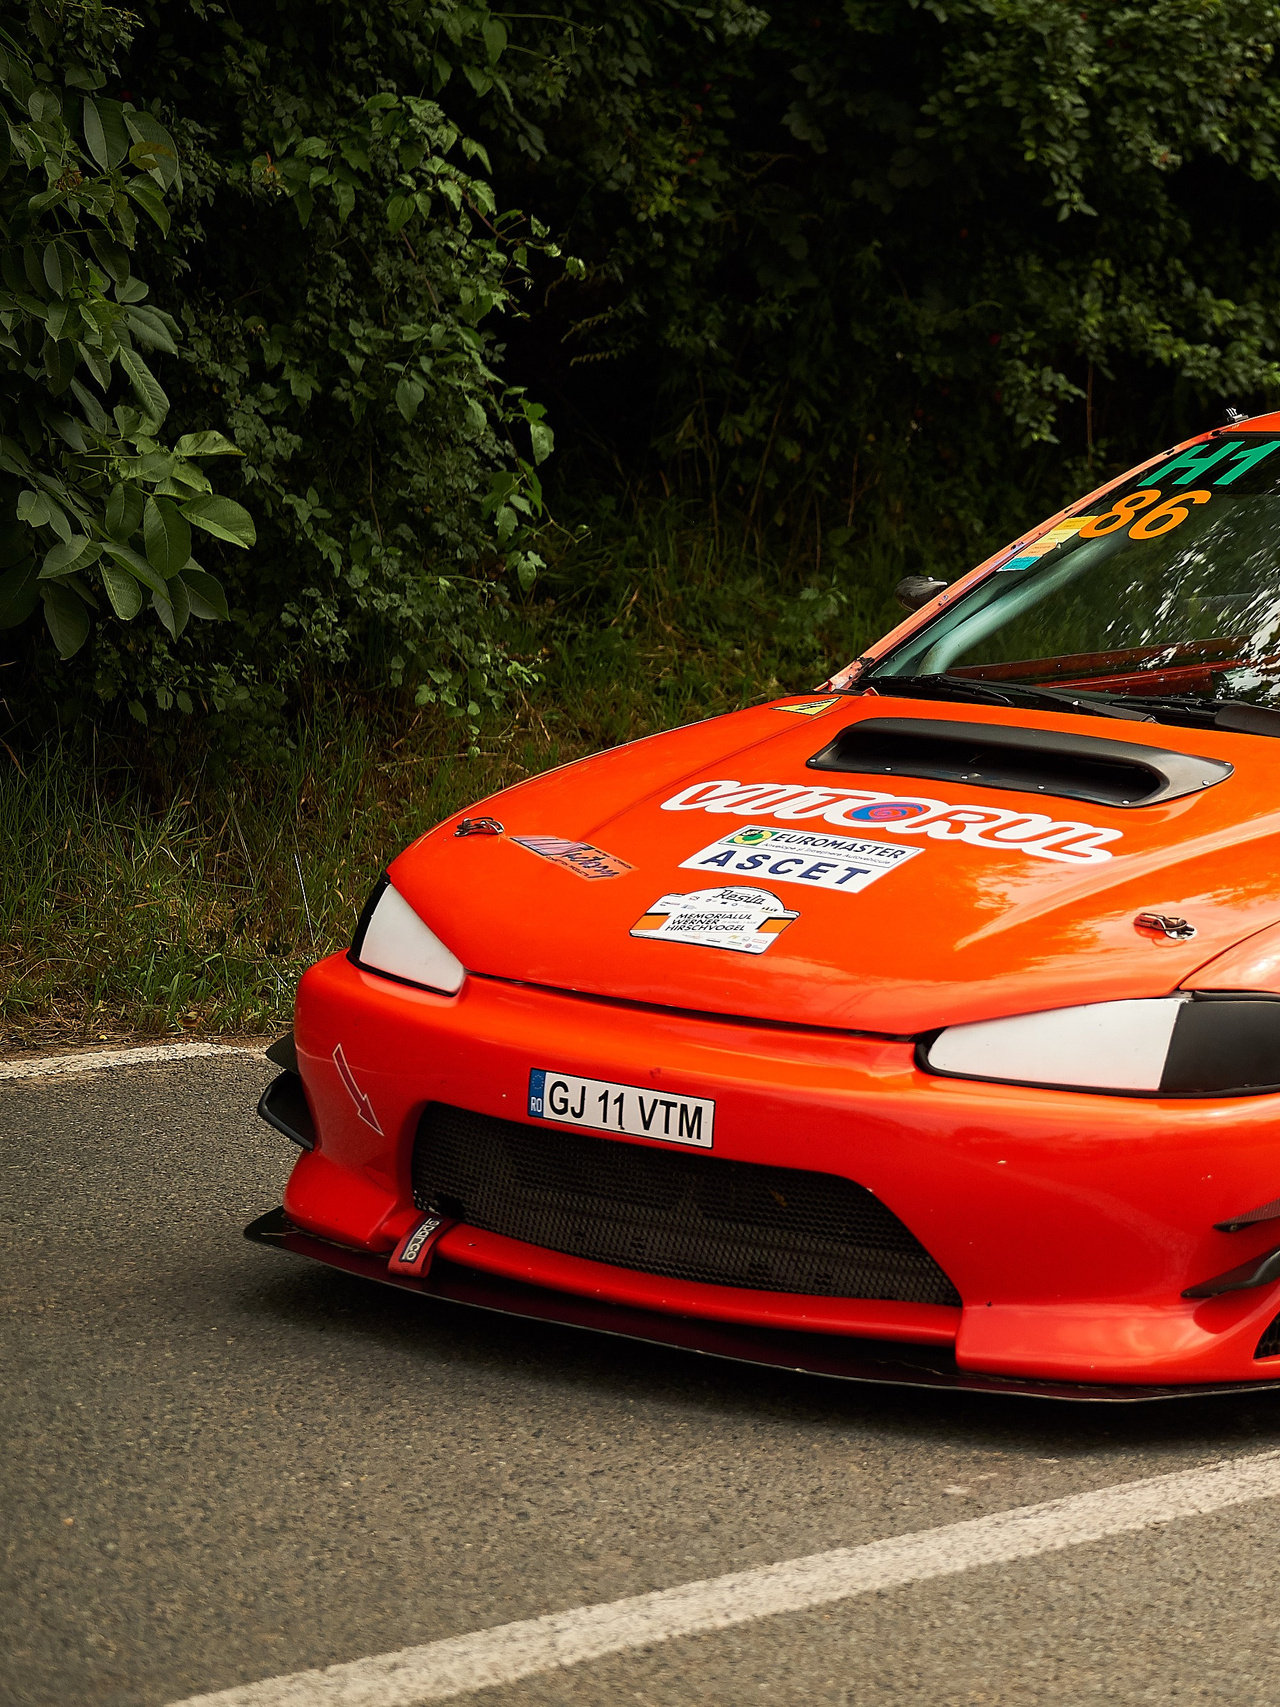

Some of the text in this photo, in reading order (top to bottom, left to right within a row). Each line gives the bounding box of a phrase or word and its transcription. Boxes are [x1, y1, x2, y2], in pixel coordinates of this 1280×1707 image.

[1078, 489, 1212, 540] 86
[772, 833, 907, 860] EUROMASTER
[698, 850, 872, 885] ASCET
[671, 918, 720, 926] WERNER
[675, 912, 753, 920] MEMORIALUL
[665, 924, 745, 932] HIRSCHVOGEL
[530, 1096, 542, 1113] RO
[549, 1080, 703, 1140] GJ 11 VTM
